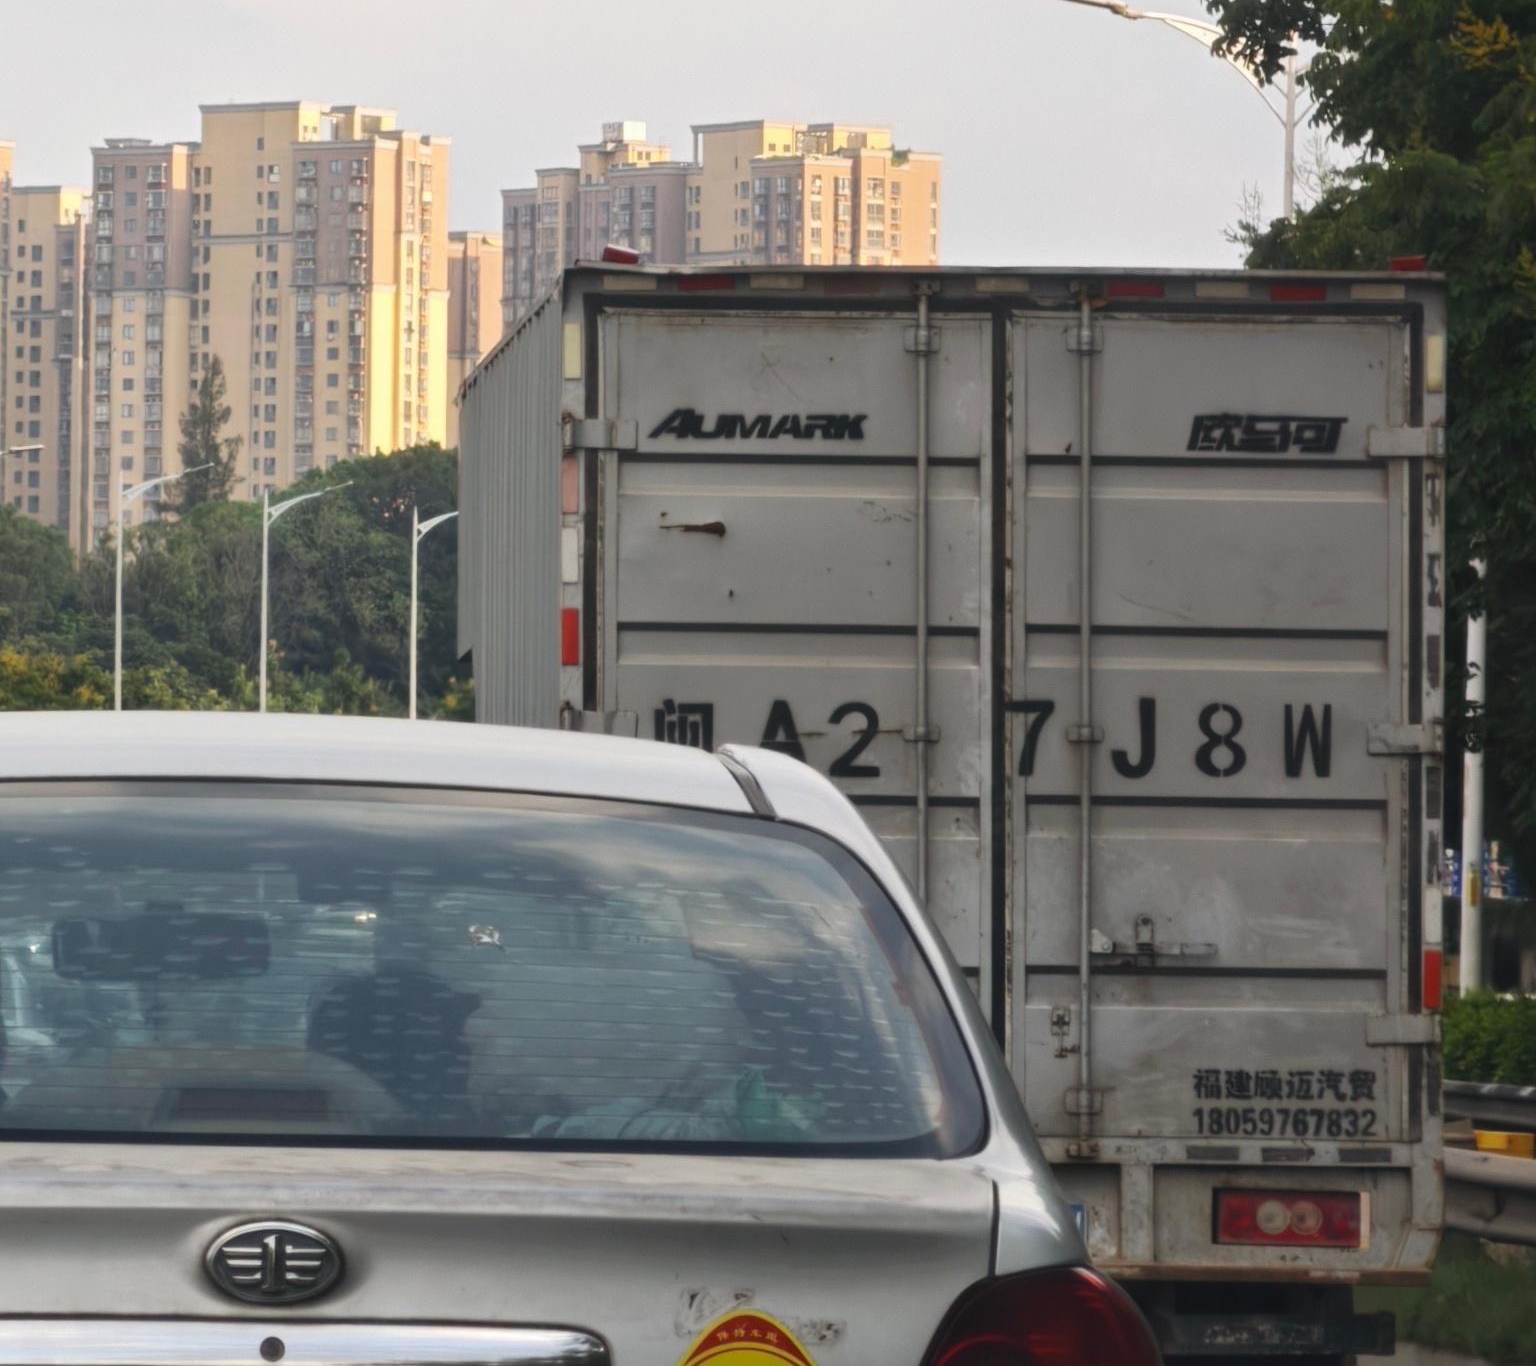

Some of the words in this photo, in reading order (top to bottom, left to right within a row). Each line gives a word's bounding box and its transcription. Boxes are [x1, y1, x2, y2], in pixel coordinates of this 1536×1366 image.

[648, 408, 868, 439] AUMARK
[1186, 411, 1349, 453] 欧马可
[1192, 1108, 1377, 1136] 18059767832
